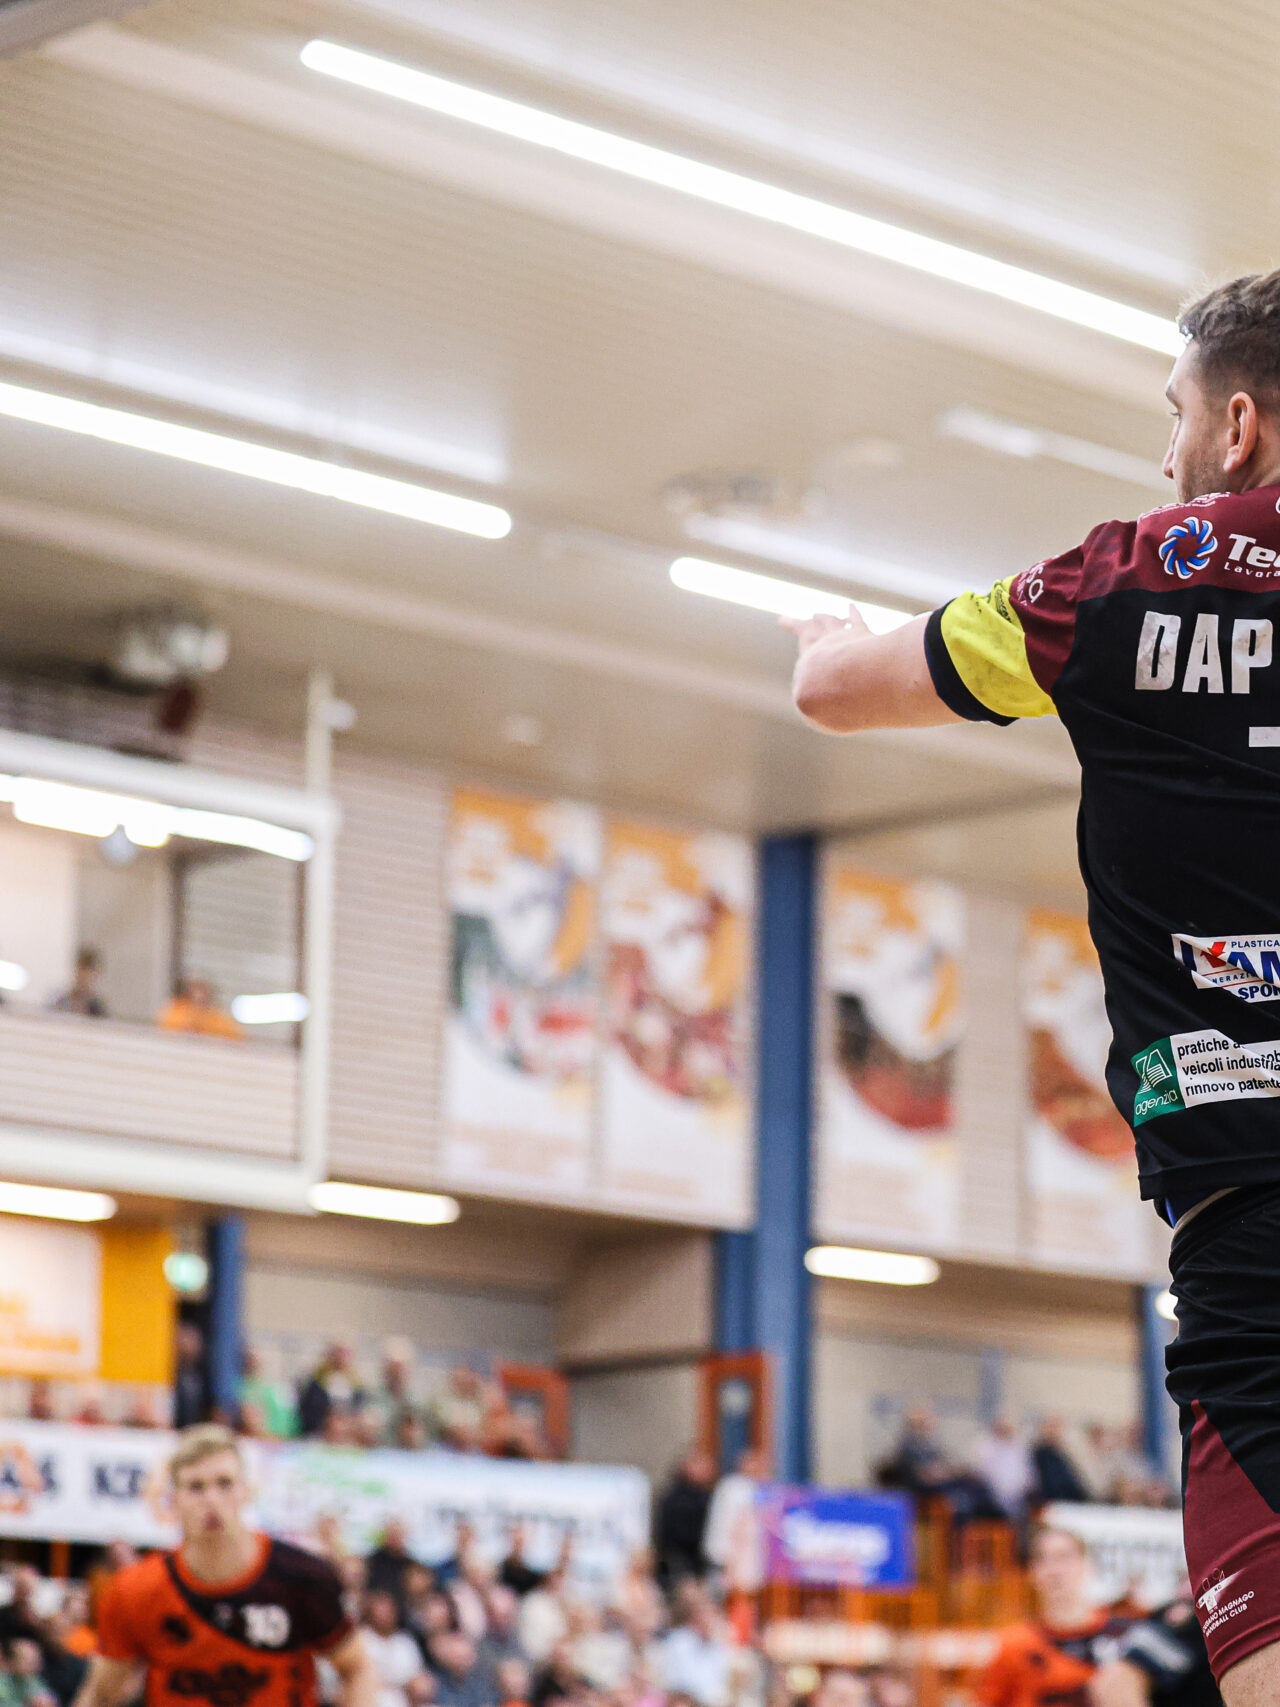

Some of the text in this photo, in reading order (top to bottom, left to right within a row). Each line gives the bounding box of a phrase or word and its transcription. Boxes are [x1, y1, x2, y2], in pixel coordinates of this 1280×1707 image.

[1231, 940, 1280, 949] PLASTICA
[1177, 1037, 1229, 1060] pratiche
[1182, 1057, 1224, 1076] veicoli
[1185, 1077, 1235, 1096] rinnovo
[1135, 1089, 1178, 1116] agenzia
[1218, 1591, 1255, 1616] MAGNAGO
[1229, 1603, 1248, 1618] CLUB
